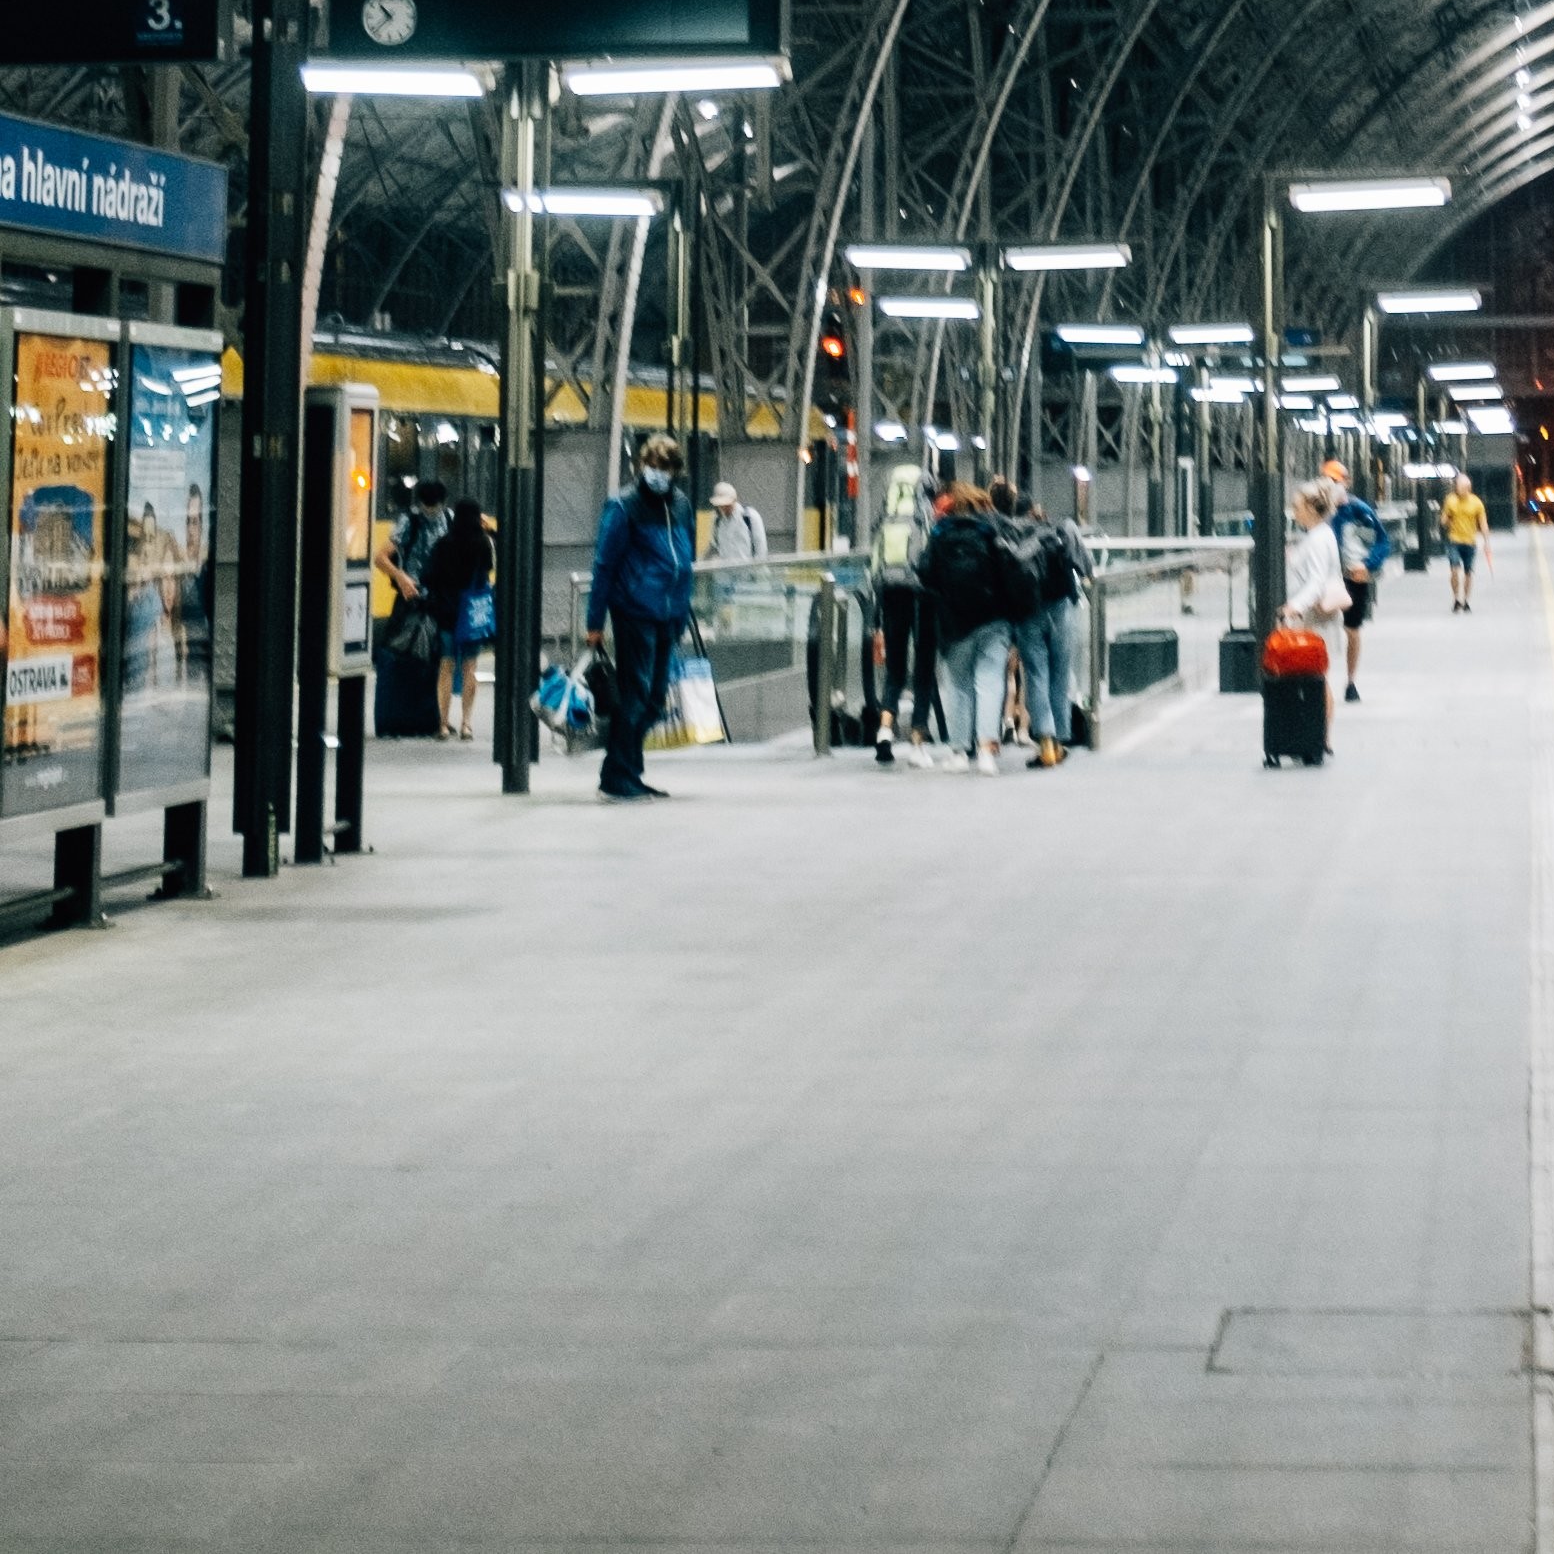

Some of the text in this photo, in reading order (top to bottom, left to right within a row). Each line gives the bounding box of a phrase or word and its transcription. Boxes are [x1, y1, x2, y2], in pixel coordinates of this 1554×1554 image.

[21, 145, 89, 213] hlavní
[92, 161, 166, 228] nádraží
[8, 665, 57, 698] OSTRAVA
